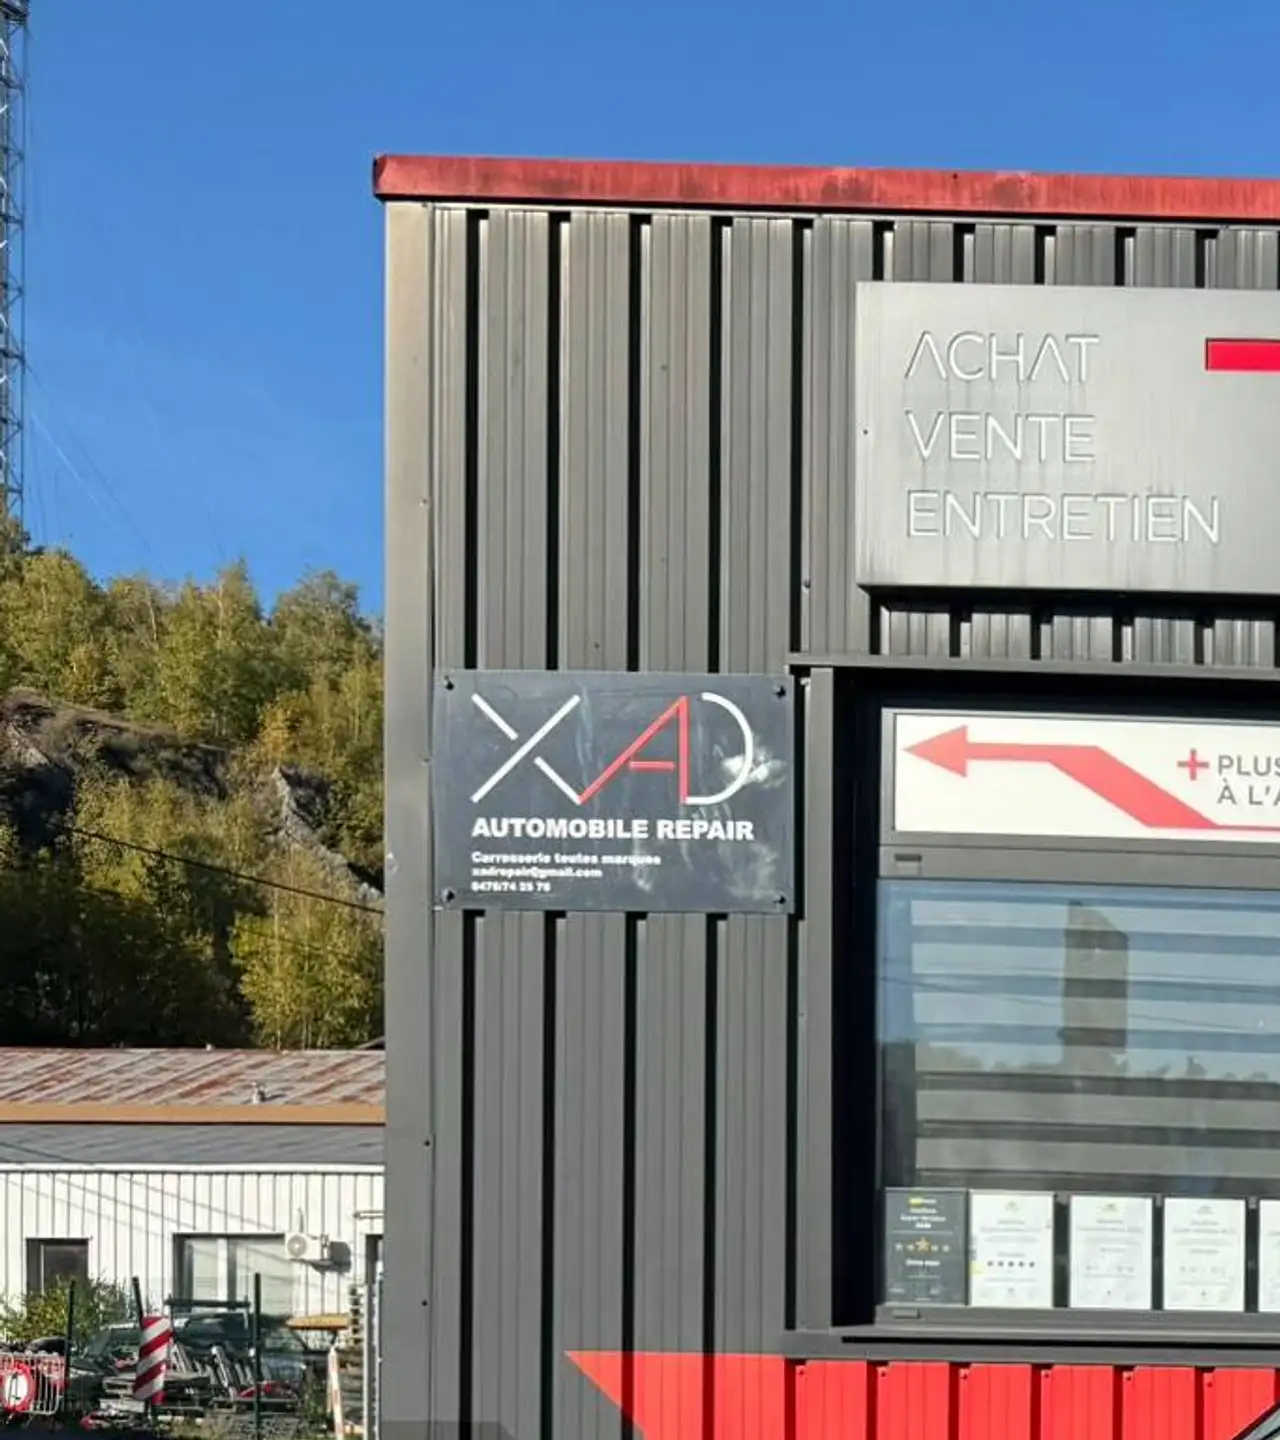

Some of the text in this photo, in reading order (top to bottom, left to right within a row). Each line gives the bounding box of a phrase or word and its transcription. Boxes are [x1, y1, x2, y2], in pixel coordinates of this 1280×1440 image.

[904, 330, 1100, 384] ACHAT
[904, 410, 1097, 463] VENTE
[906, 489, 1221, 545] ENTRETIEN
[470, 691, 754, 806] XAD
[1216, 780, 1238, 805] À
[470, 817, 755, 842] AUTOMOBILE REPAIR
[470, 851, 662, 867] Carrosserie toutes marques
